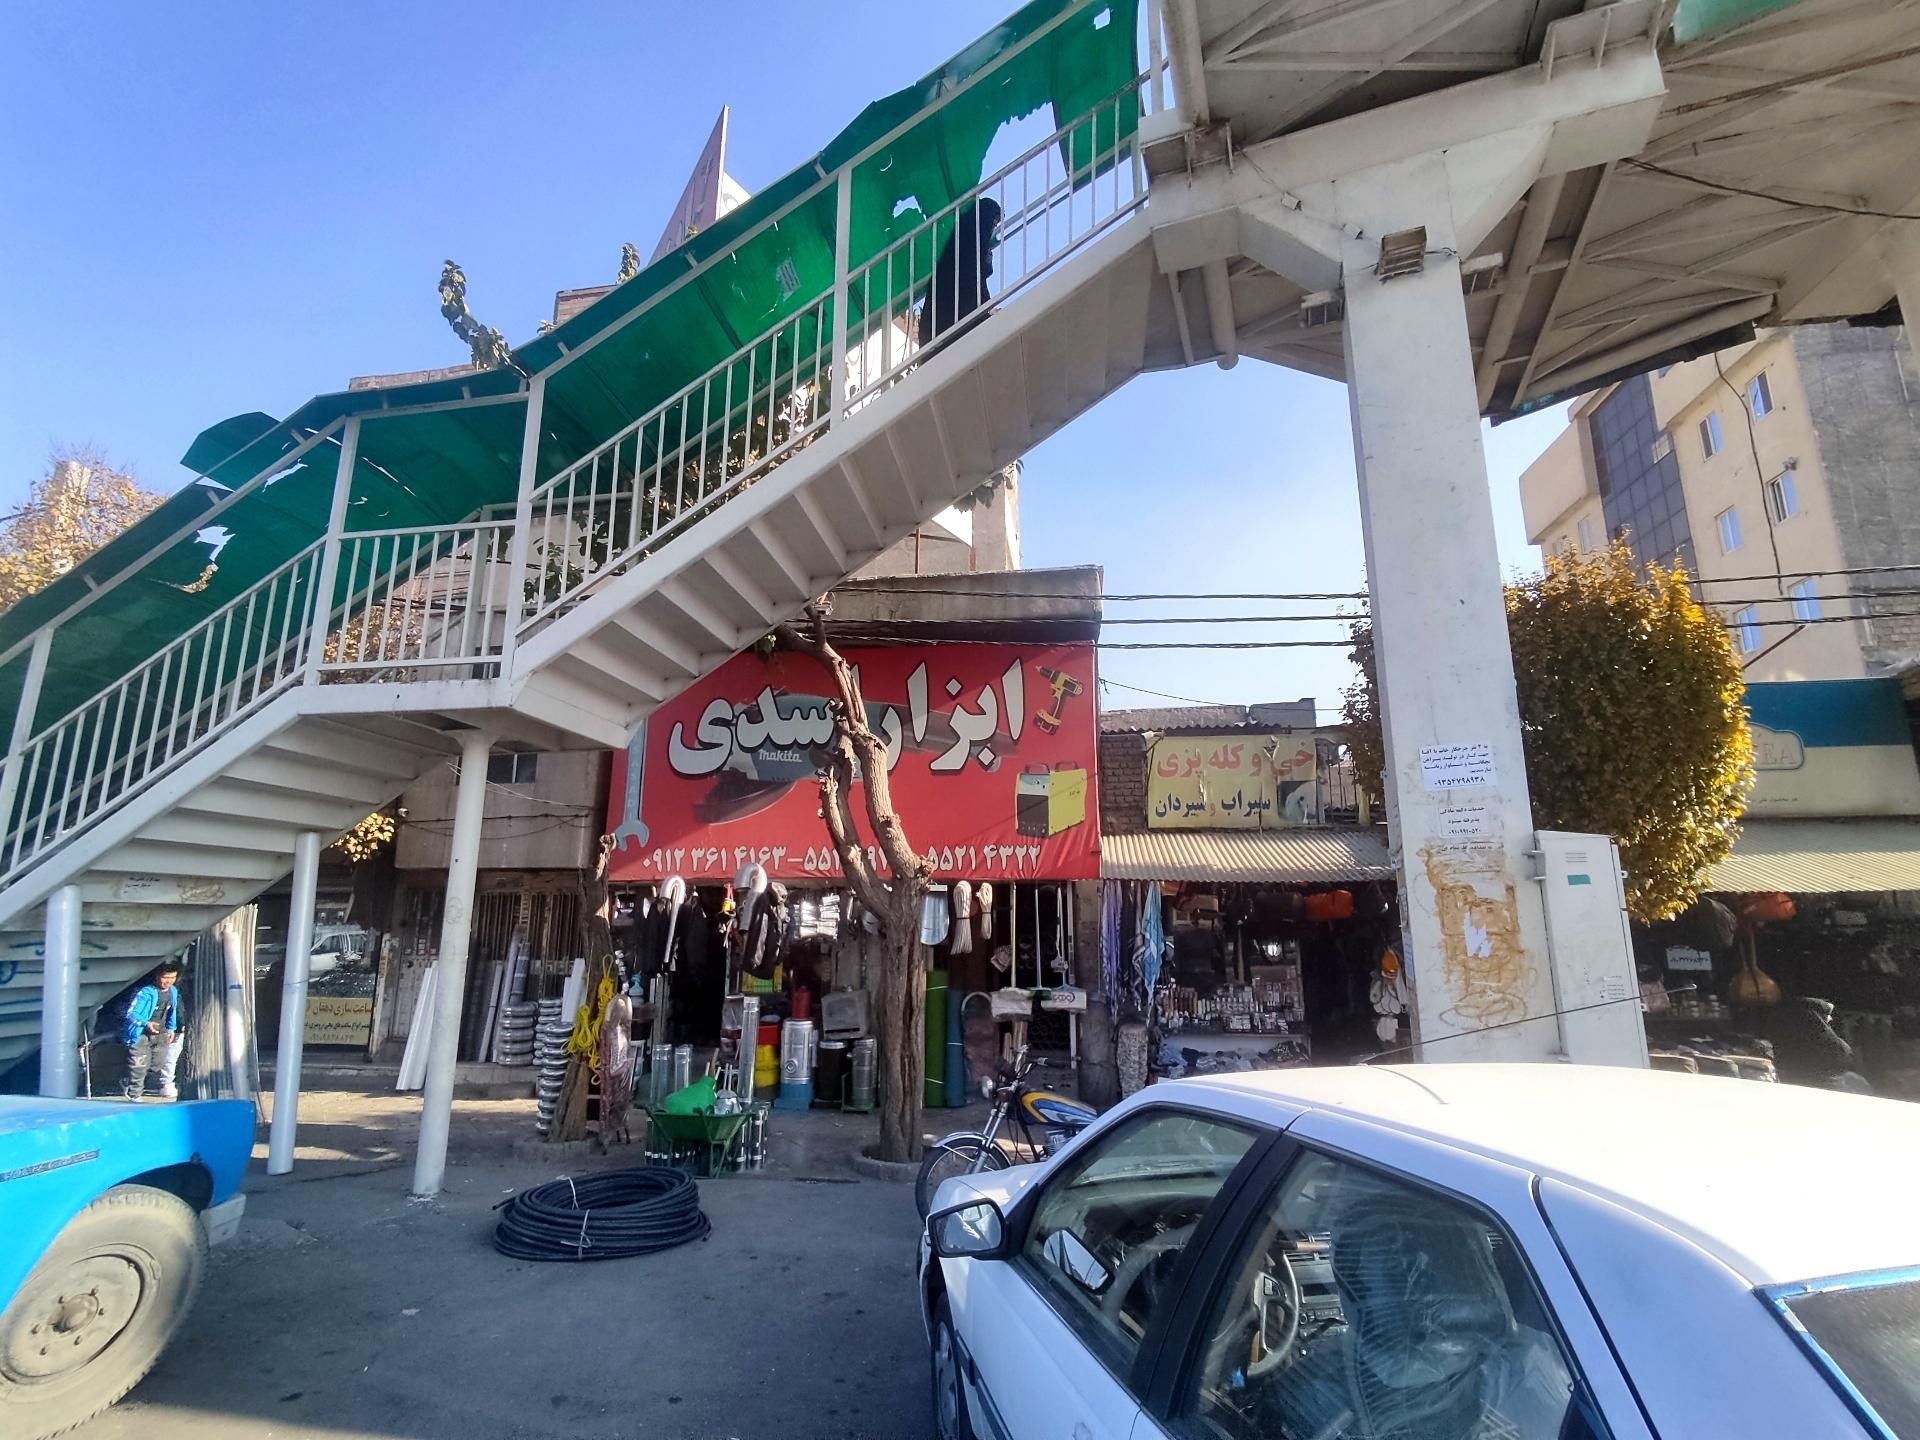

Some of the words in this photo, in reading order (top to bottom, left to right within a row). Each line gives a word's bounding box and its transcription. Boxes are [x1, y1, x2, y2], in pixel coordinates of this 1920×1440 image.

[668, 663, 860, 776] سدی
[881, 657, 1025, 772] ابزار
[758, 749, 803, 763] makita
[1208, 743, 1244, 770] کله
[643, 847, 686, 873] ۰۹۱۲
